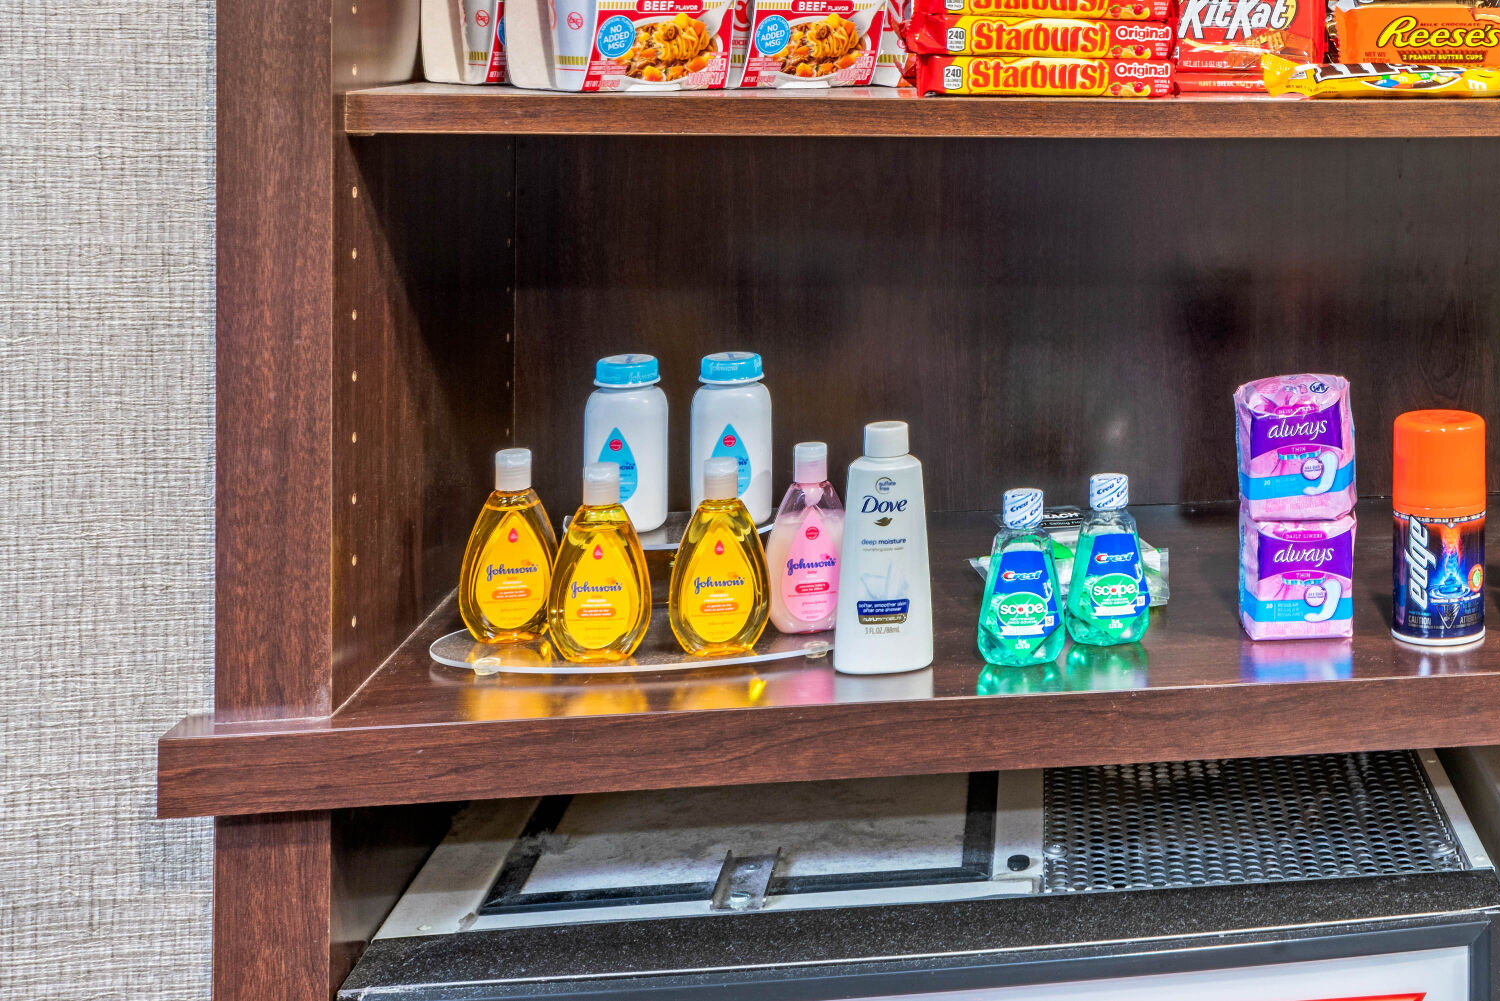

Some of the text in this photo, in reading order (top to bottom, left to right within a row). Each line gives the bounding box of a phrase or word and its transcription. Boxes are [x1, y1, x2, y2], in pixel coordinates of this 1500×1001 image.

[643, 0, 674, 11] BEEF
[798, 0, 826, 12] BEEF
[974, 22, 1172, 54] Starburst Original
[970, 59, 1170, 92] Starburst Original
[1268, 418, 1328, 442] always
[861, 495, 908, 514] Dove
[786, 555, 837, 576] Johnson's
[1096, 552, 1134, 563] Crest
[1273, 546, 1334, 568] always
[1405, 516, 1437, 610] edge
[486, 562, 539, 582] Johnson's
[1003, 570, 1043, 581] Crest
[570, 580, 624, 599] Johnson's
[694, 574, 746, 595] Johnson's
[1094, 583, 1137, 597] scope
[1000, 602, 1046, 617] scope
